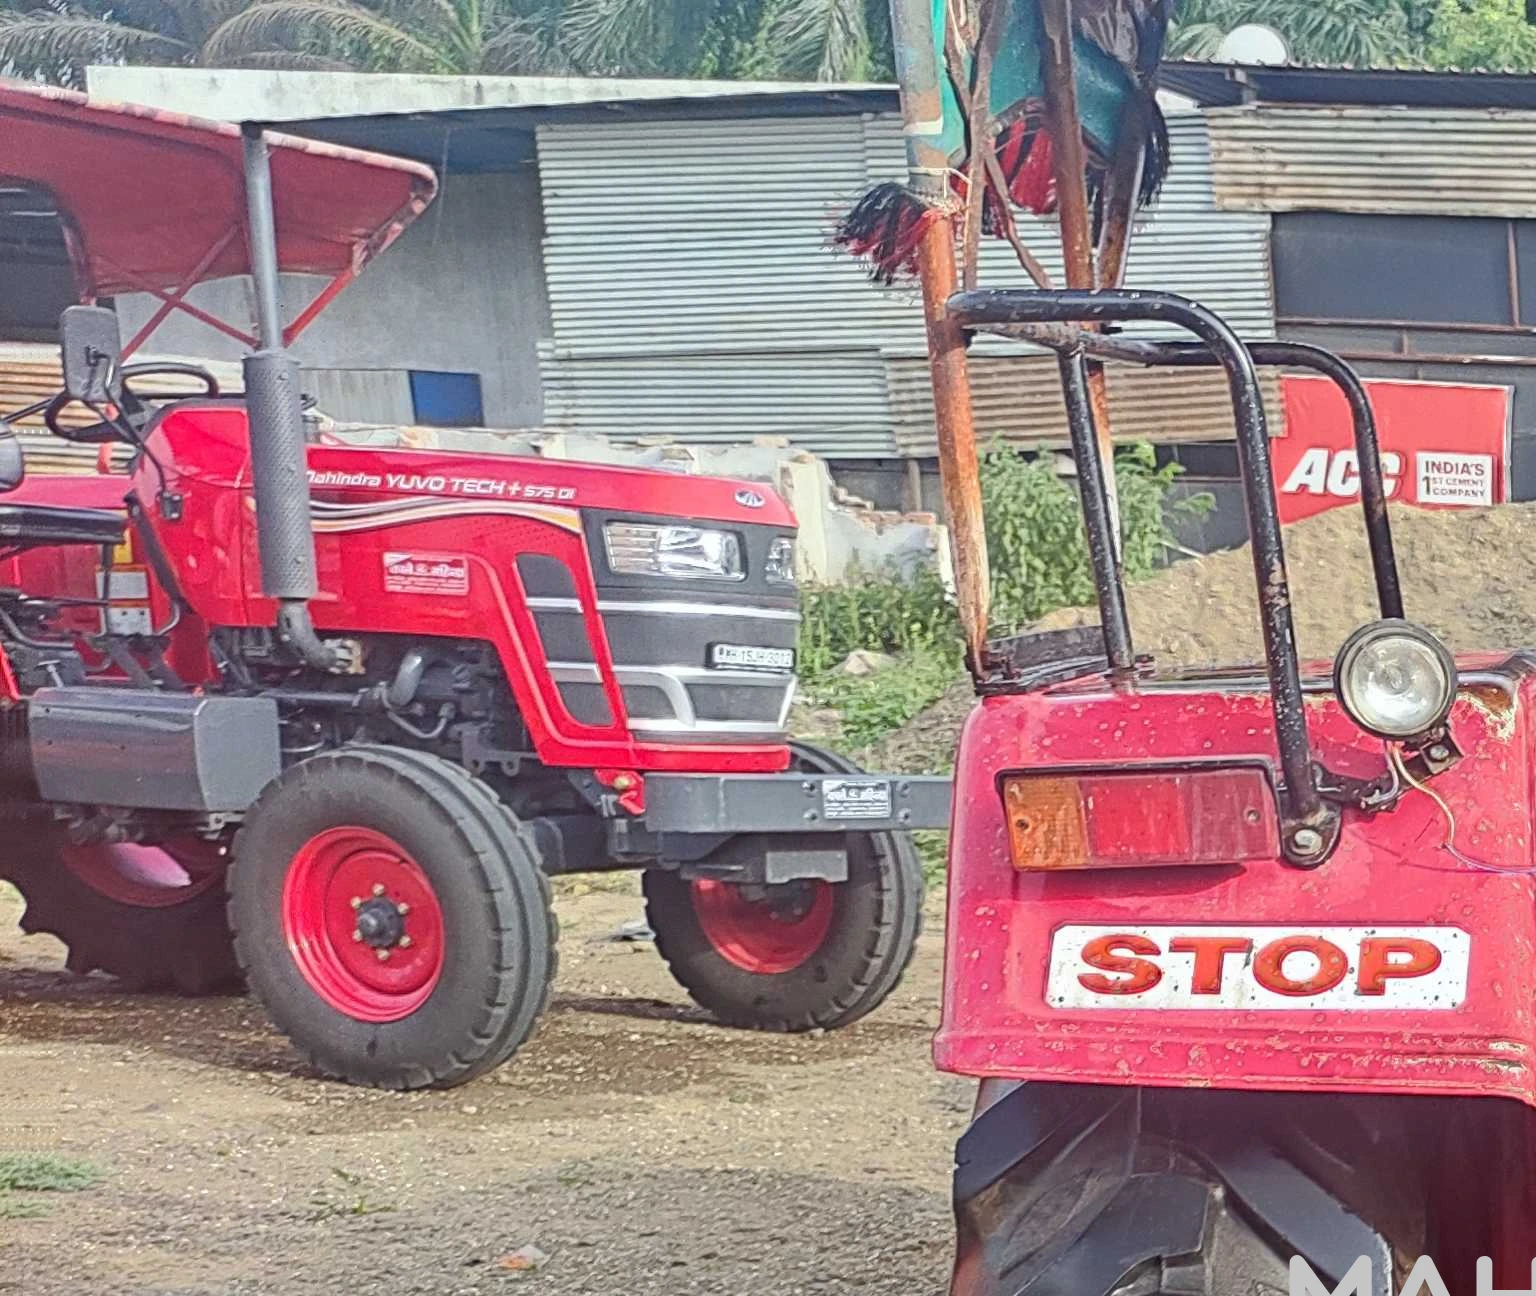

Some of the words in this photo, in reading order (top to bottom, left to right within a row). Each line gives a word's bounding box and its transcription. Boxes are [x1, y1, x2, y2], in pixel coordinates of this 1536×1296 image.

[1424, 460, 1485, 476] INDIA'S
[387, 473, 445, 491] YUVO
[523, 485, 555, 498] 575
[1432, 487, 1485, 498] COMPANY
[1076, 933, 1443, 997] STOP
